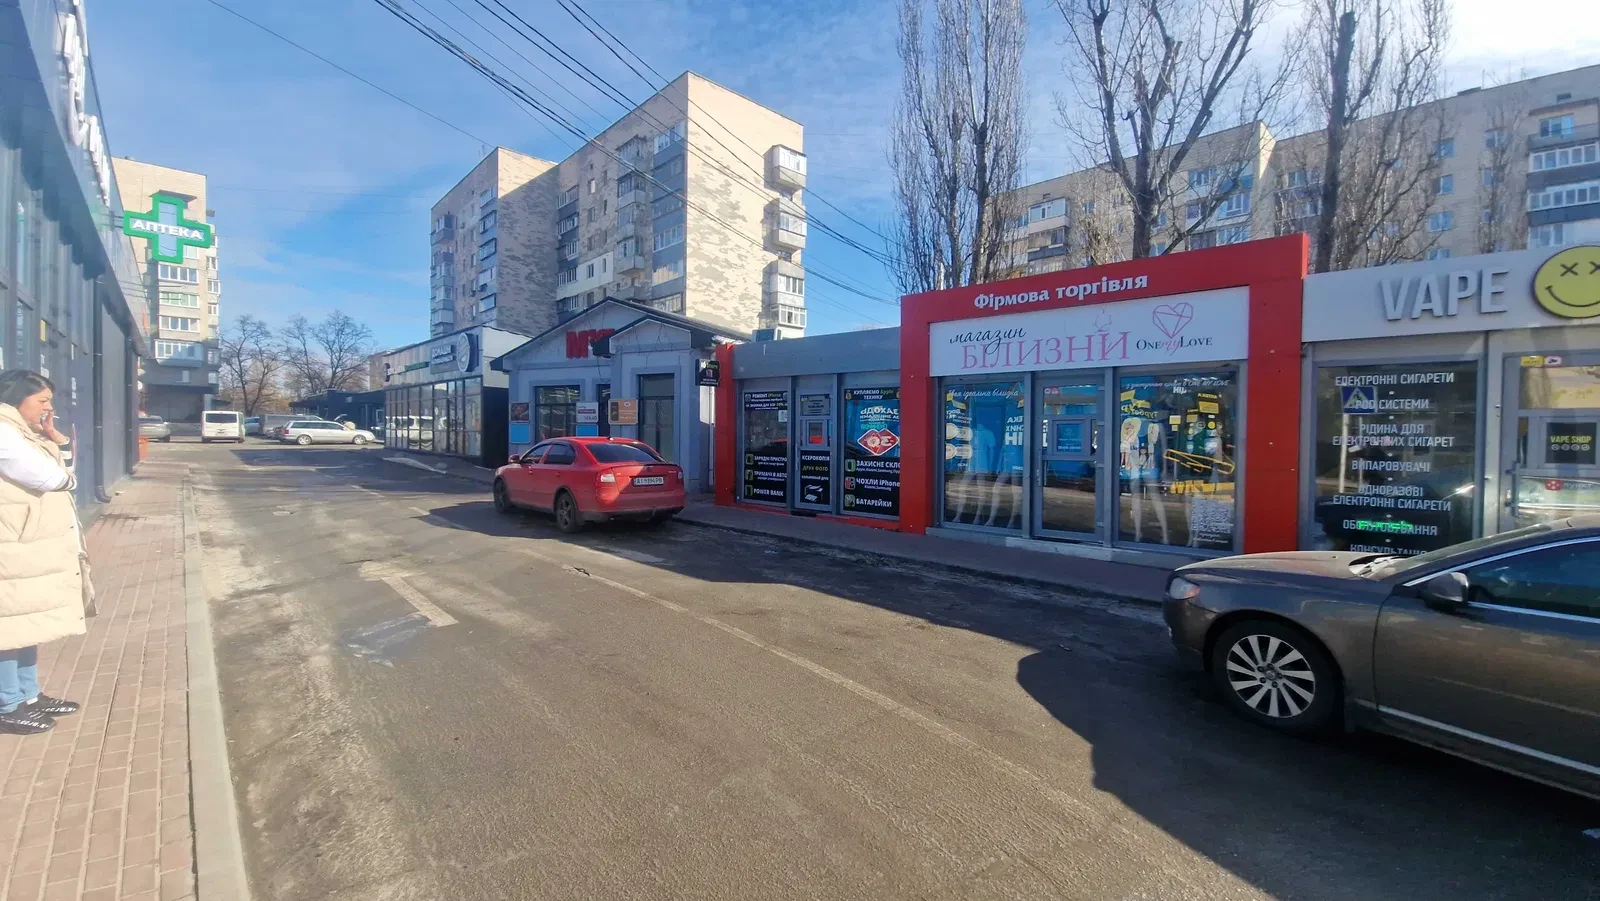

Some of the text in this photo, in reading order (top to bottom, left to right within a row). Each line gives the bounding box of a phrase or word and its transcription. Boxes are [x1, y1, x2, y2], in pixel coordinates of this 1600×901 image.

[132, 219, 204, 240] АПТЕКА
[974, 275, 1148, 311] Фірмова торгівля
[1379, 268, 1509, 321] VAPE
[949, 325, 1027, 354] магазин
[1335, 372, 1454, 387] ЕЛЕКТРОННІ СИГАРЕТИ
[1379, 399, 1429, 410] СИСТЕМИ
[1360, 423, 1424, 435] РІДИНА ДЛЯ
[1408, 436, 1455, 447] СИГАРЕТ
[1550, 435, 1592, 443] VAPE SHOP
[856, 460, 885, 468] ЗАХИСНЕ
[1351, 460, 1430, 472] ВИПАРОВУВАЧІ
[879, 479, 901, 487] iPhone
[1358, 484, 1423, 497] ОДНОРАЗОВІ
[856, 498, 892, 508] БАТАРЕЙКИ
[1332, 495, 1451, 511] ЕЛЕКТРОННІ СИГАРЕТИ
